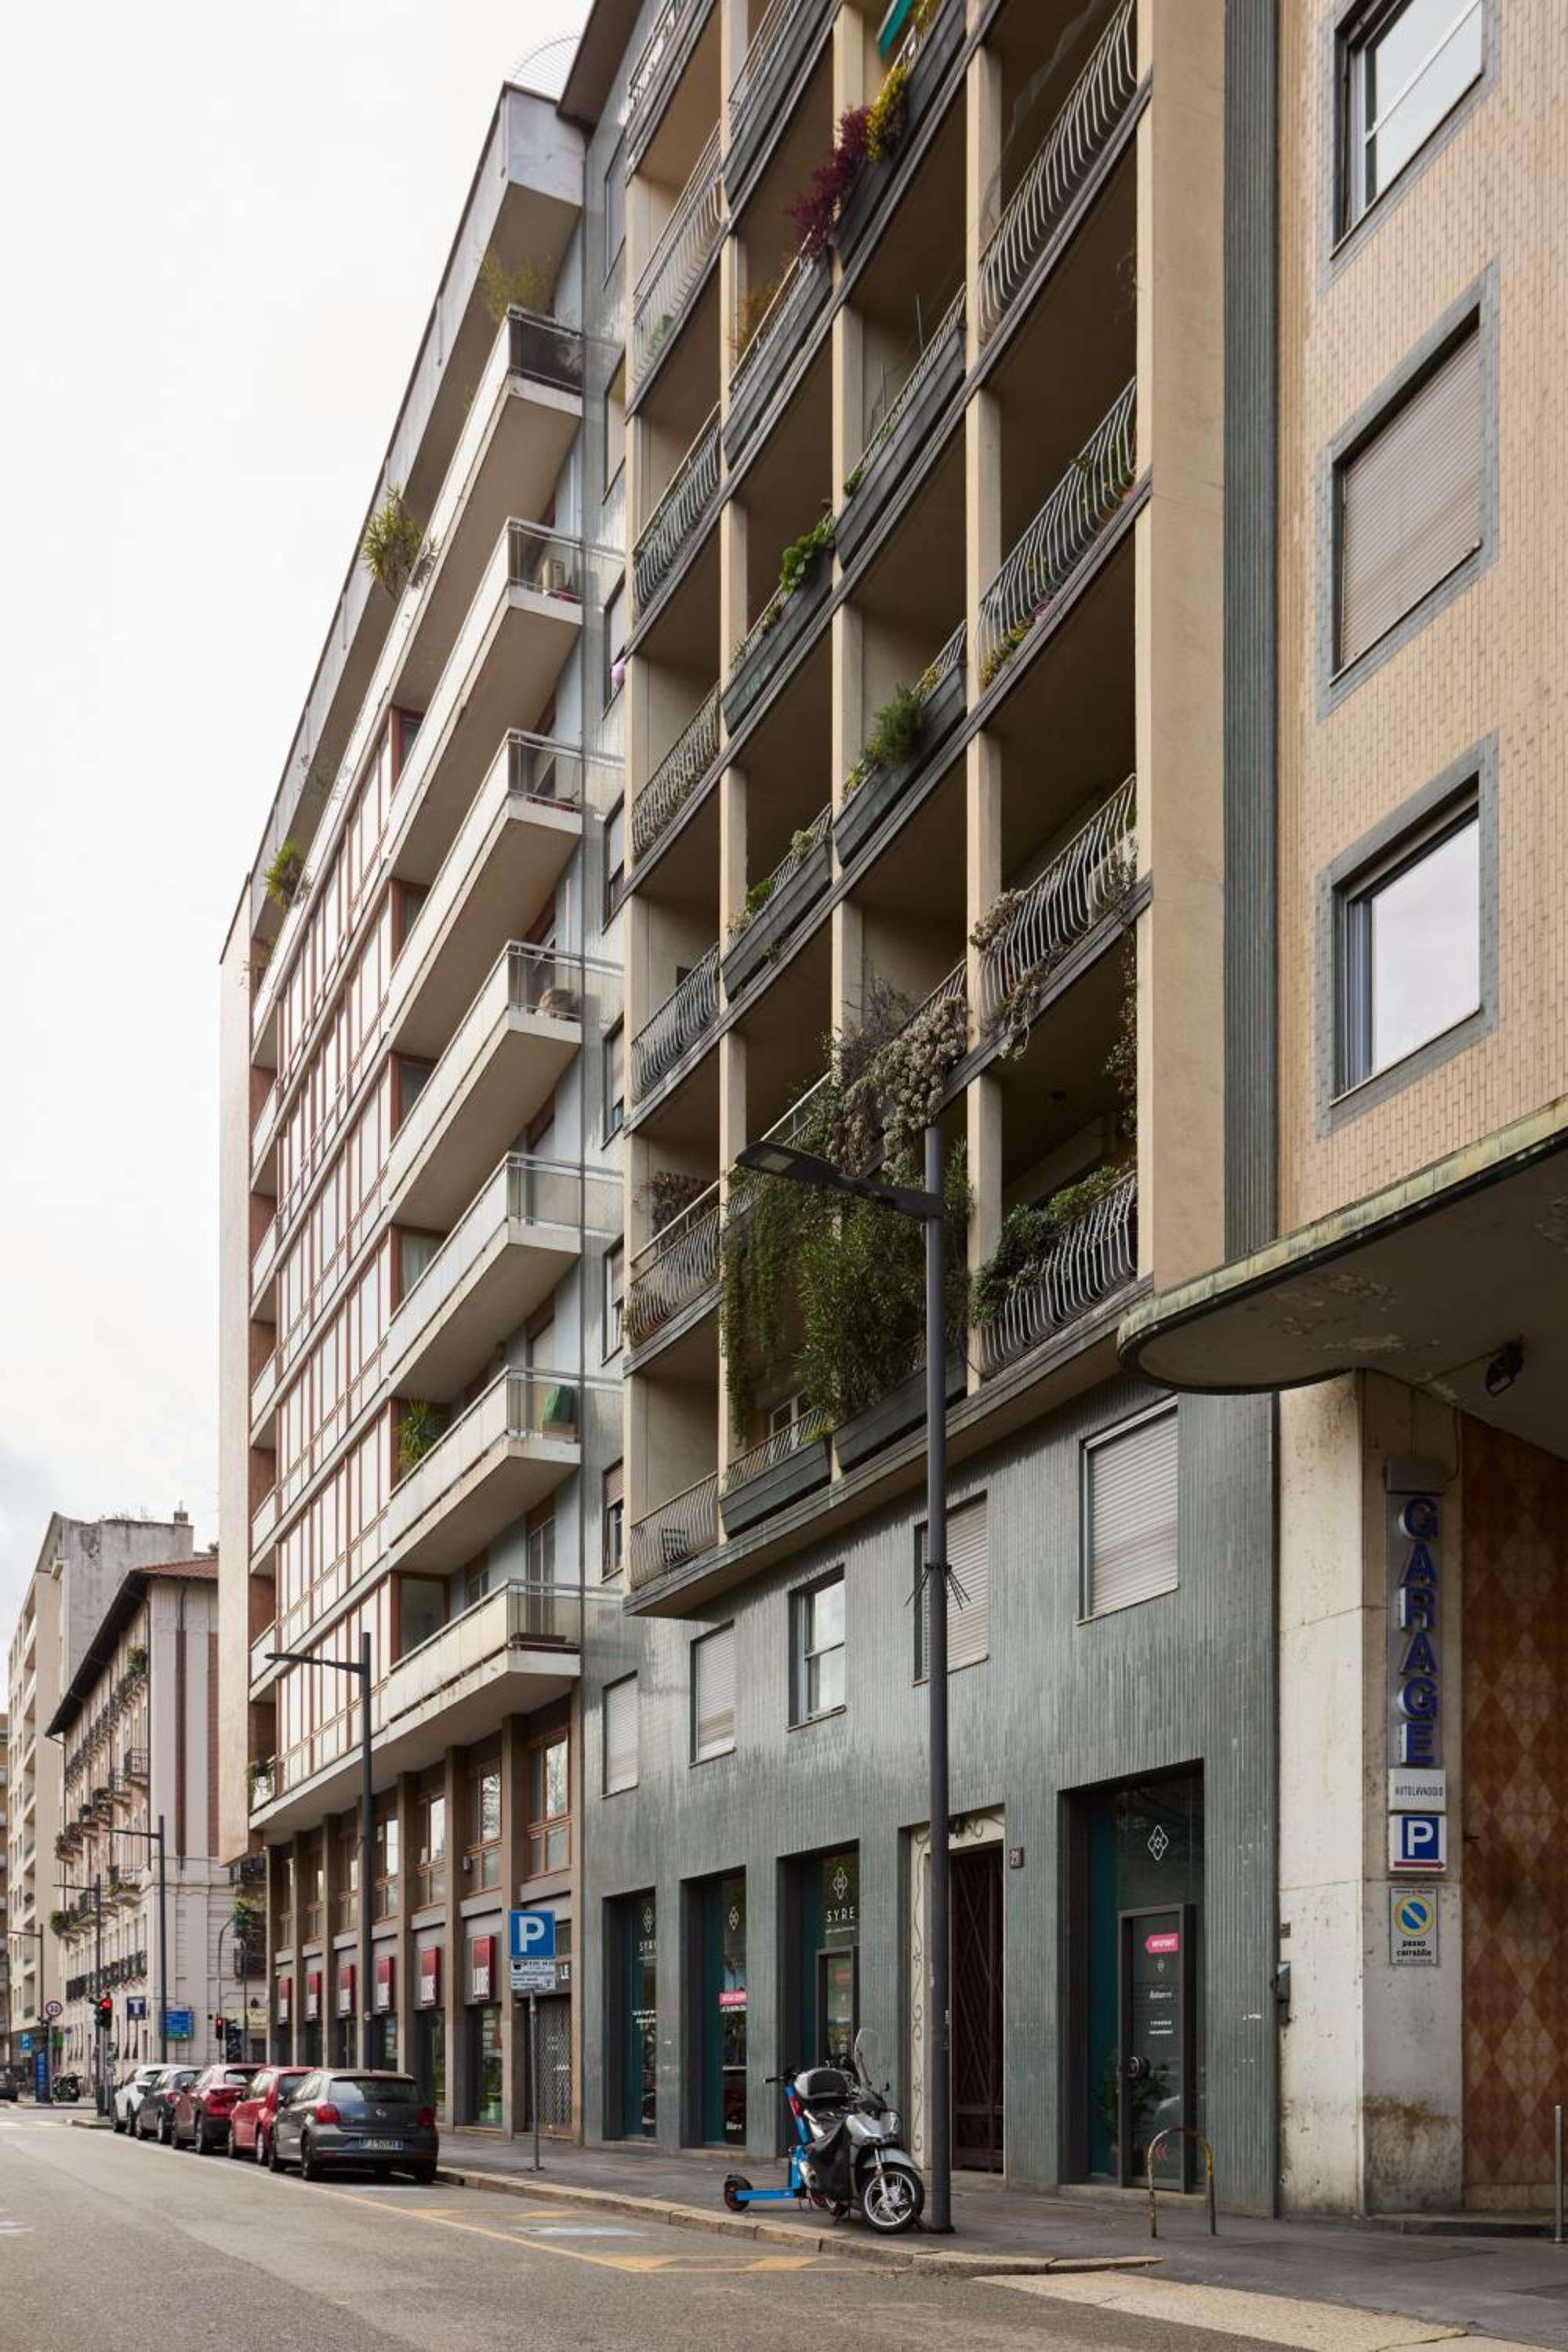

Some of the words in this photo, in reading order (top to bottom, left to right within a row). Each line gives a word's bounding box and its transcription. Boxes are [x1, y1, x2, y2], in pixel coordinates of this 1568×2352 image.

[1399, 1497, 1438, 1766] GARAGE
[1407, 1820, 1434, 1857] P
[827, 1906, 855, 1922] SYRE
[518, 1916, 545, 1952] P
